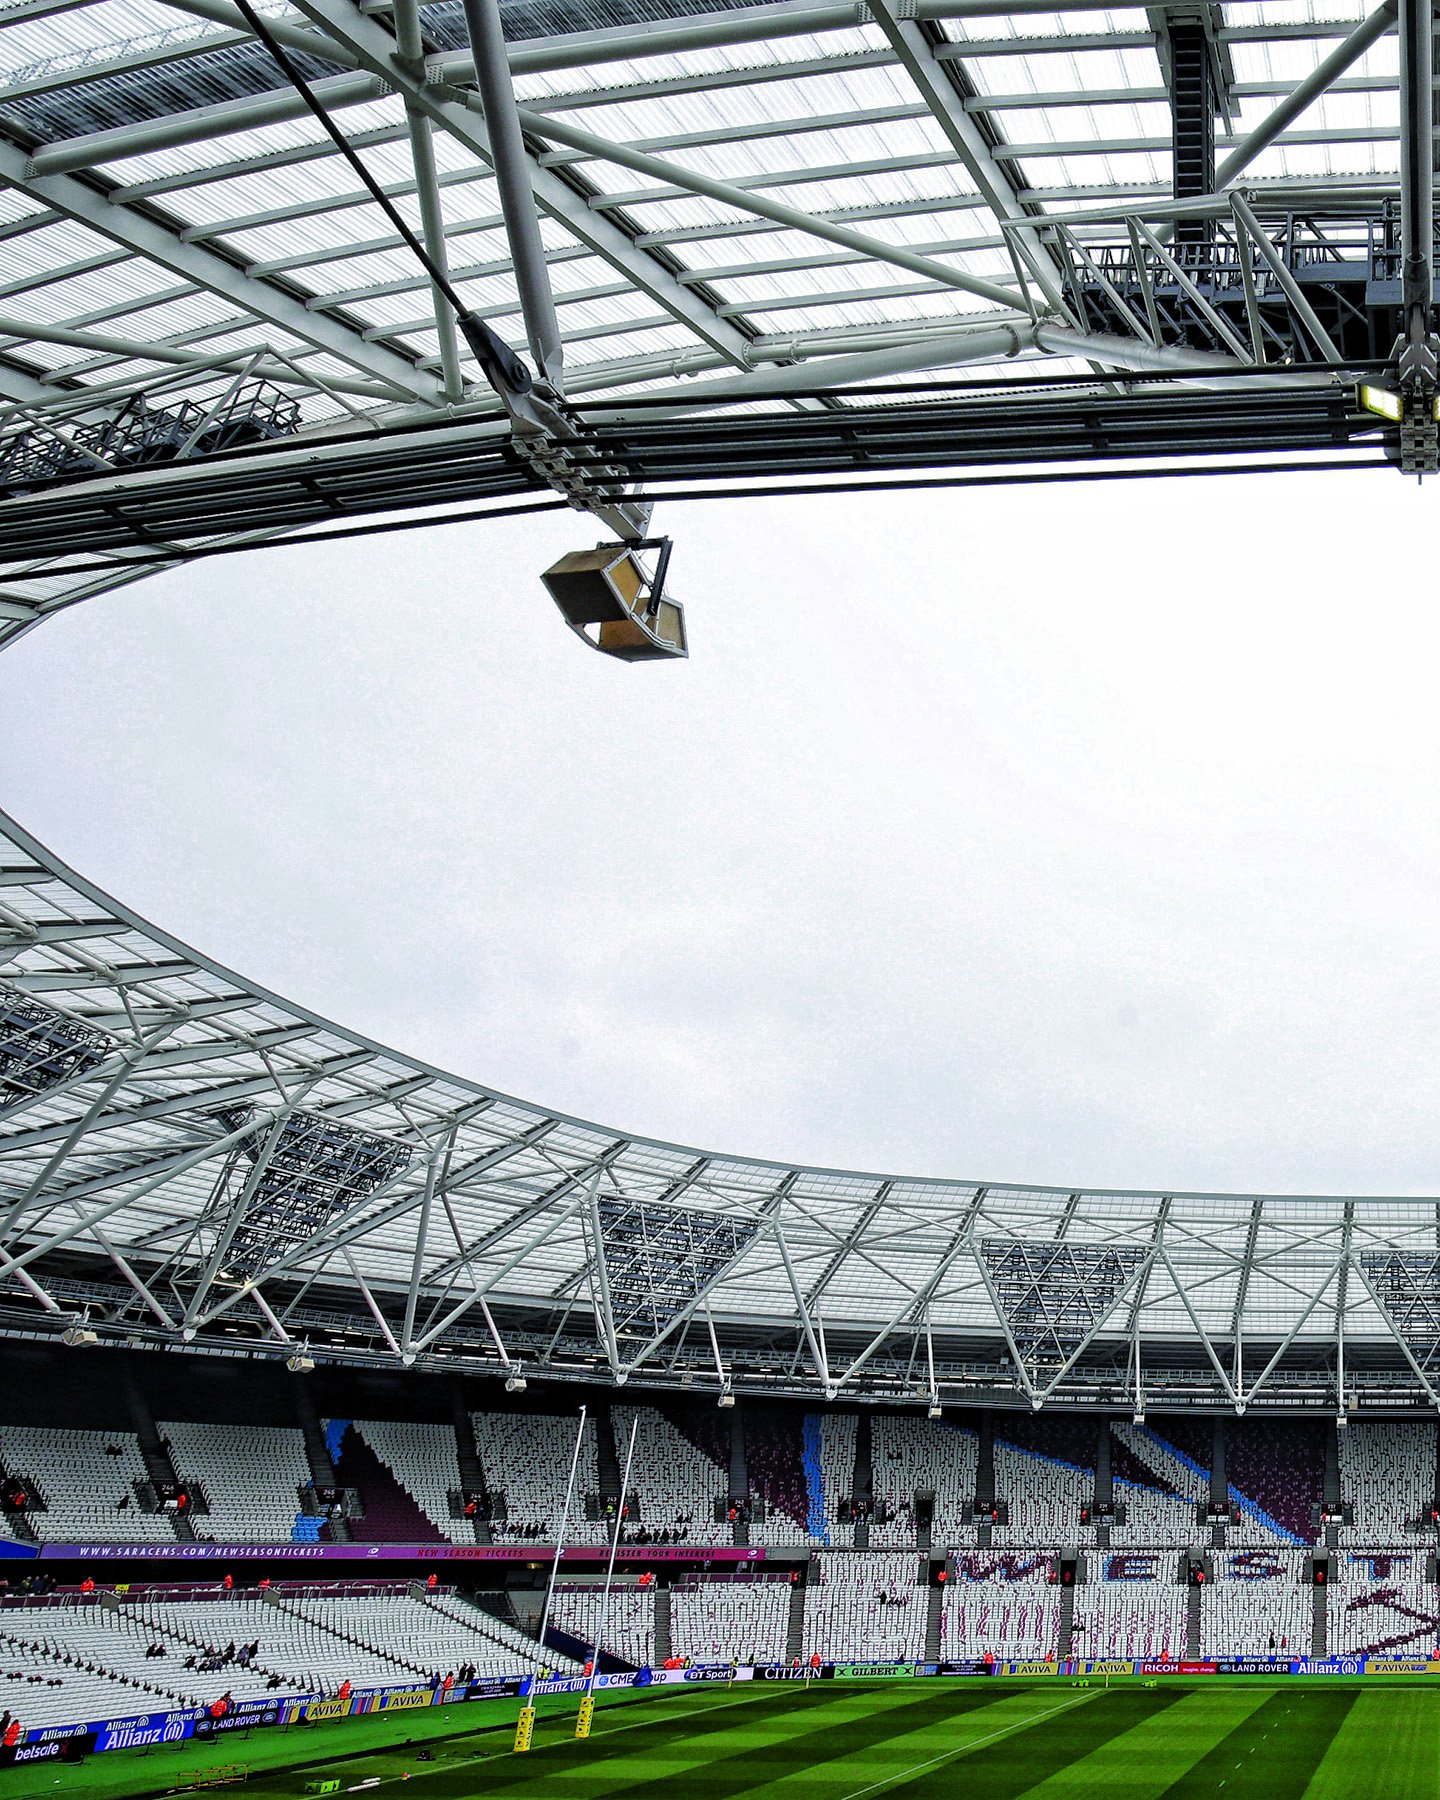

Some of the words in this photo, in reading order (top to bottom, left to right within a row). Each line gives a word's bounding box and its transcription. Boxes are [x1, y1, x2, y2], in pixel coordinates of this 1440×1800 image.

[79, 1547, 325, 1558] WWW.SARACENS.COM/NEWSEASONTICKETS
[417, 1549, 440, 1558] NEW
[443, 1549, 481, 1558] SEASON
[485, 1549, 525, 1558] TICKETS
[851, 1667, 899, 1676] GILBERT
[1020, 1665, 1051, 1674] AVIVA
[1097, 1664, 1127, 1673] AVIVA
[1144, 1664, 1179, 1673] RICOH
[1232, 1664, 1255, 1672] LAND
[1258, 1664, 1289, 1672] ROVER
[1297, 1662, 1340, 1675] Allianz
[1382, 1663, 1412, 1672] AVIVA
[690, 1671, 705, 1680] BT
[706, 1670, 732, 1680] Sport
[764, 1666, 823, 1680] CITIZEN
[477, 1678, 496, 1687] Allianz
[504, 1674, 523, 1684] Allianz
[609, 1675, 634, 1684] CME
[351, 1690, 374, 1699] Allianz
[383, 1687, 405, 1697] Allianz
[283, 1697, 311, 1707] Allianz
[392, 1694, 425, 1708] AVIVA
[239, 1703, 267, 1714] Allianz
[311, 1705, 343, 1718] AVIVA
[165, 1712, 194, 1723] Allianz
[212, 1717, 234, 1730] LAND
[234, 1713, 261, 1727] ROVER
[105, 1720, 138, 1732] Allianz
[40, 1729, 74, 1742] Allianz
[105, 1728, 160, 1750] Allianz
[15, 1742, 60, 1761] betsafe
